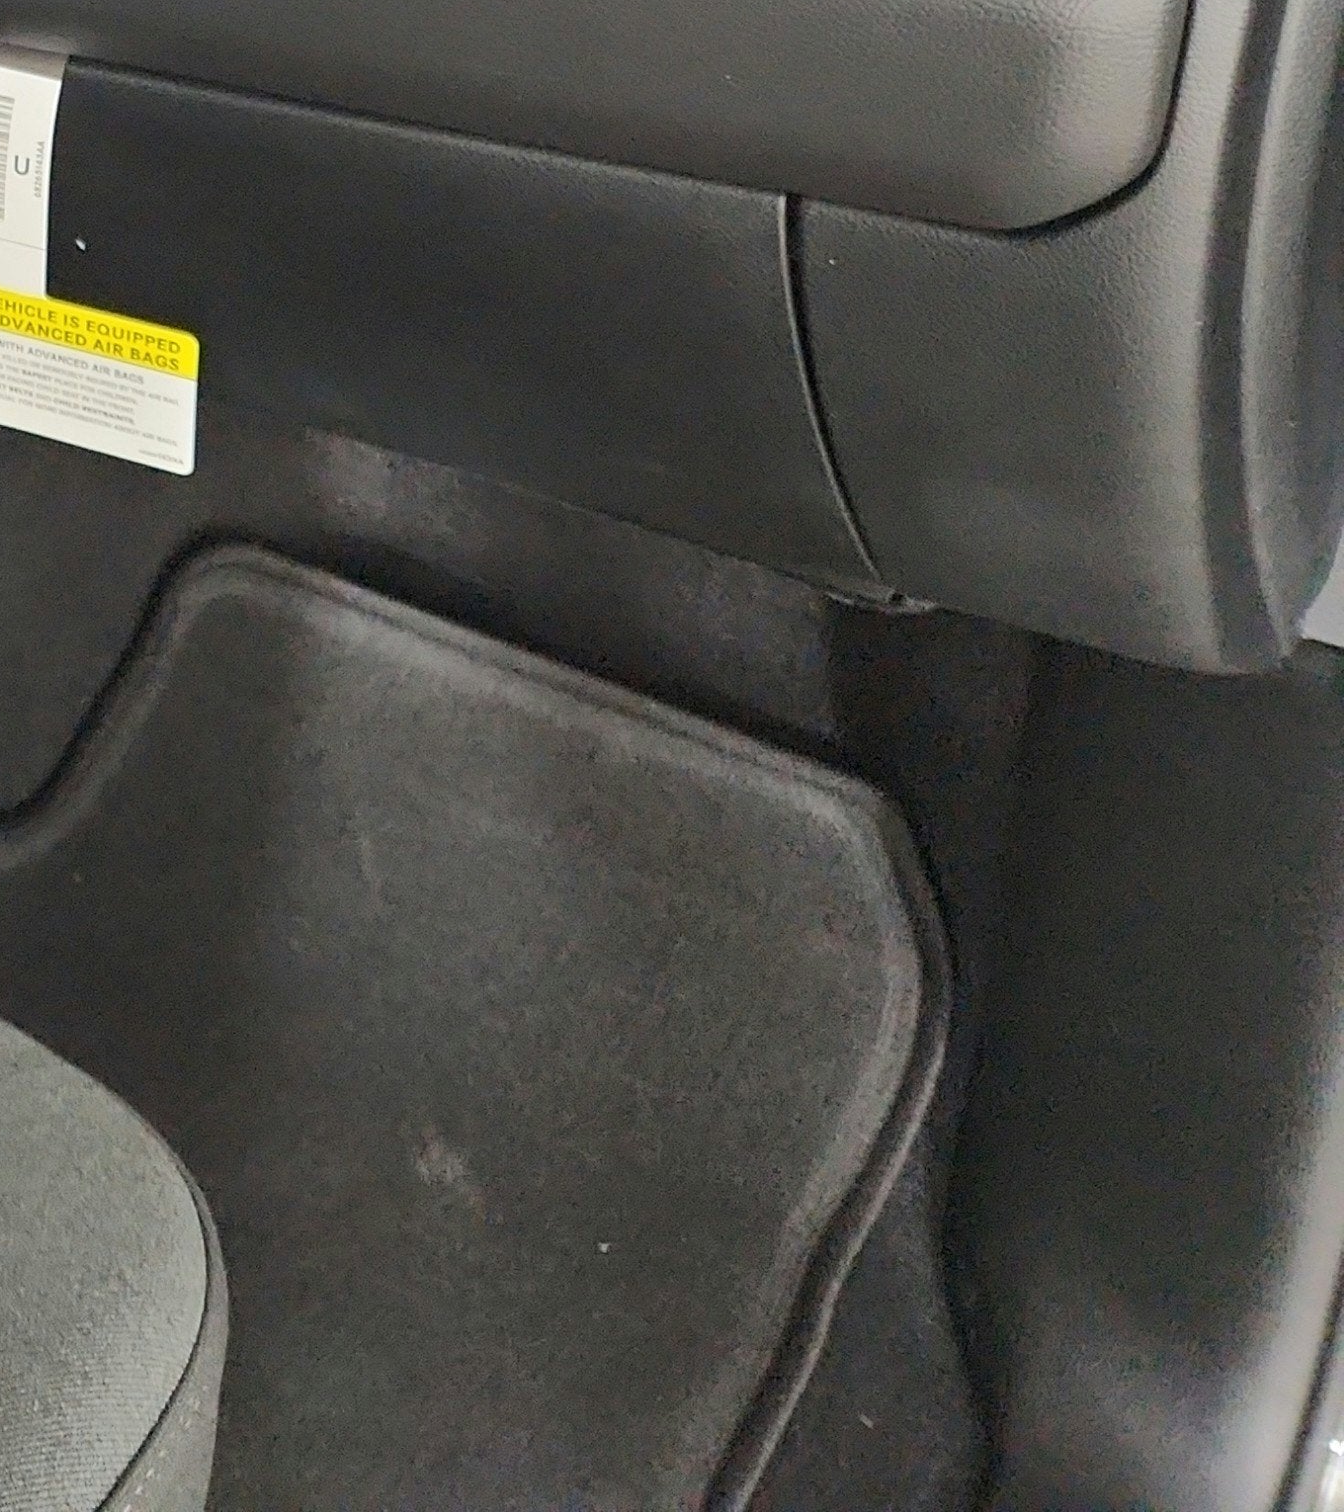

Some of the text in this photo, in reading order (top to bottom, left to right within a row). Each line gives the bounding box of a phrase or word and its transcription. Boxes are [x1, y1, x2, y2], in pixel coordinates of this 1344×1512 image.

[14, 154, 30, 176] U
[63, 314, 81, 328] IS
[85, 319, 181, 355] EQUIPPED
[27, 347, 89, 371] ADVANCED
[92, 364, 111, 376] AIR
[113, 369, 144, 385] BAGS
[92, 338, 124, 358] AIR
[129, 348, 180, 371] BAGS
